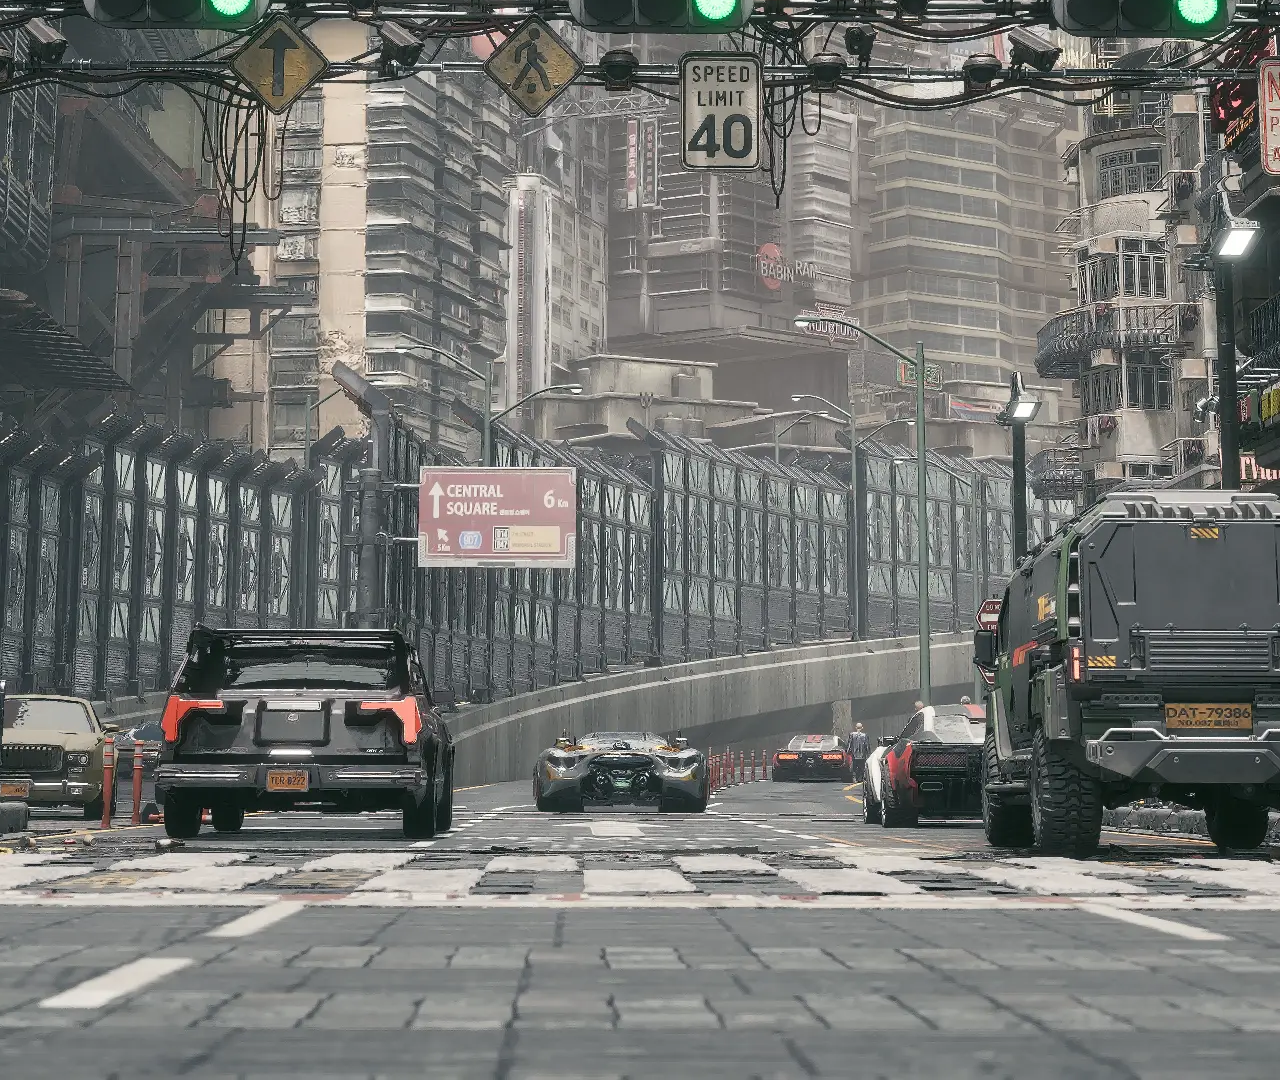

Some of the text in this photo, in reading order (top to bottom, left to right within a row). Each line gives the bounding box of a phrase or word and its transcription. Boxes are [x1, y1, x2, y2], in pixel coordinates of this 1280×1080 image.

[692, 65, 750, 82] SPEED
[697, 90, 745, 107] LIMIT
[687, 113, 753, 159] 40
[760, 260, 794, 283] BABIN
[446, 484, 569, 509] CENTRAL 6 Km
[446, 502, 498, 516] SQUARE
[463, 534, 479, 545] 907
[1166, 707, 1251, 719] DAT-79386
